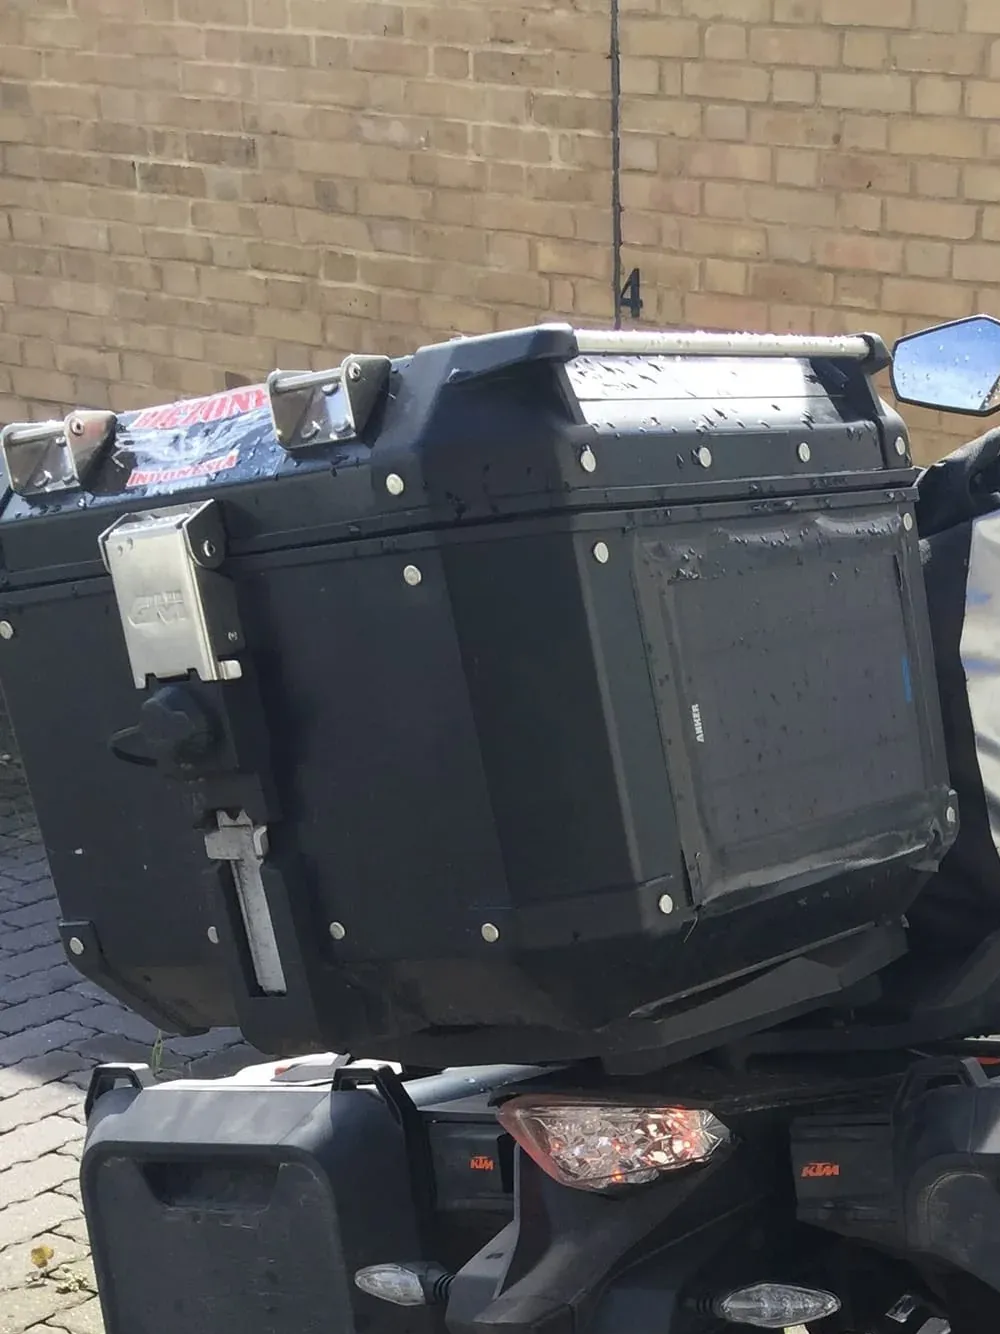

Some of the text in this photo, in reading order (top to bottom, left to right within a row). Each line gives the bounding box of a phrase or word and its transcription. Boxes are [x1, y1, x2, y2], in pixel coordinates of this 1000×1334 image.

[620, 267, 643, 318] 4
[691, 703, 705, 743] ANKER
[470, 1155, 494, 1170] KTM
[800, 1162, 840, 1177] KTM
